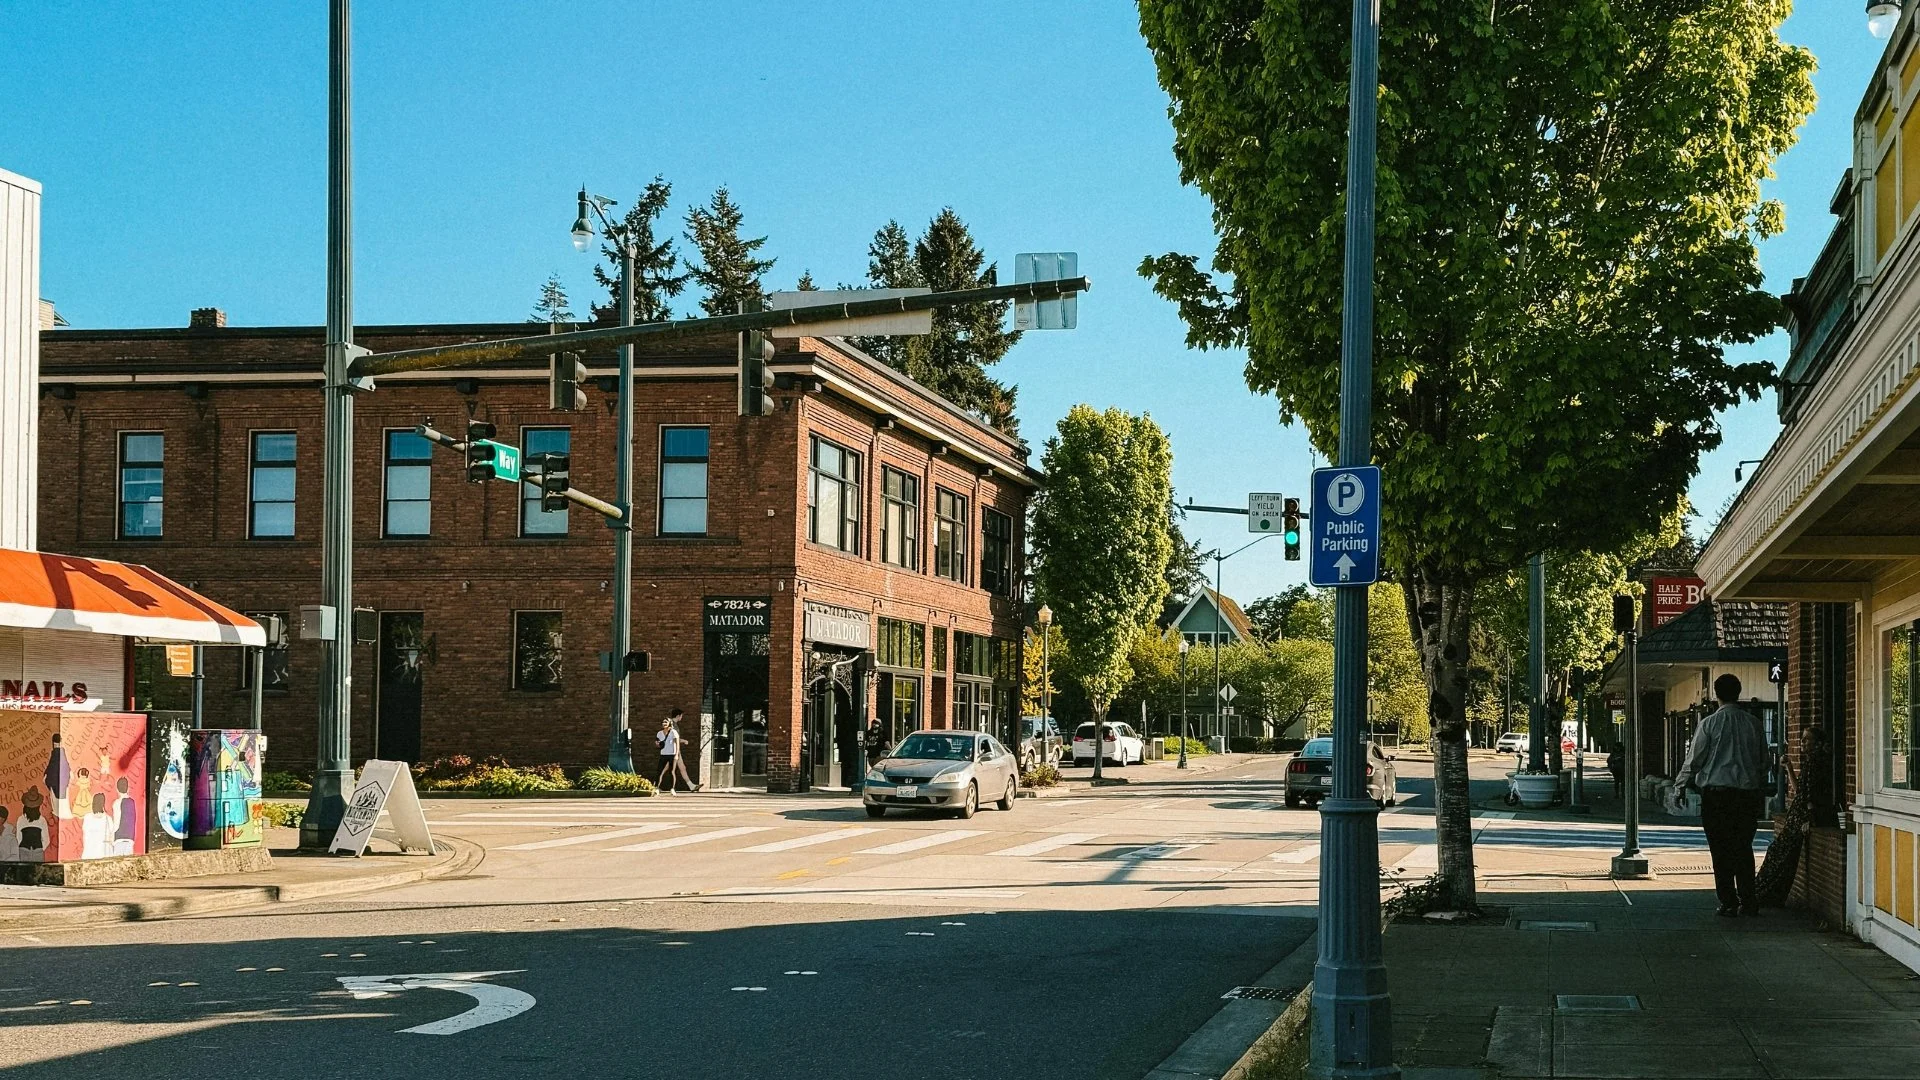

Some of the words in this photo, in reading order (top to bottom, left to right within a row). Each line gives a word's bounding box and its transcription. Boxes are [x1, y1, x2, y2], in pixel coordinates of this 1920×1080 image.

[499, 449, 516, 475] Way
[1338, 481, 1355, 508] P
[1257, 502, 1275, 510] YIELD
[1326, 520, 1365, 535] Public
[1322, 536, 1368, 553] Parking
[1658, 584, 1681, 593] HALF
[724, 600, 751, 610] 7824
[1657, 596, 1682, 605] PRICE
[709, 615, 765, 626] MATADOR
[1657, 615, 1675, 625] RE
[816, 618, 862, 643] MATADOR
[2, 680, 88, 704] NAILS
[8, 728, 51, 760] COMMUNITY
